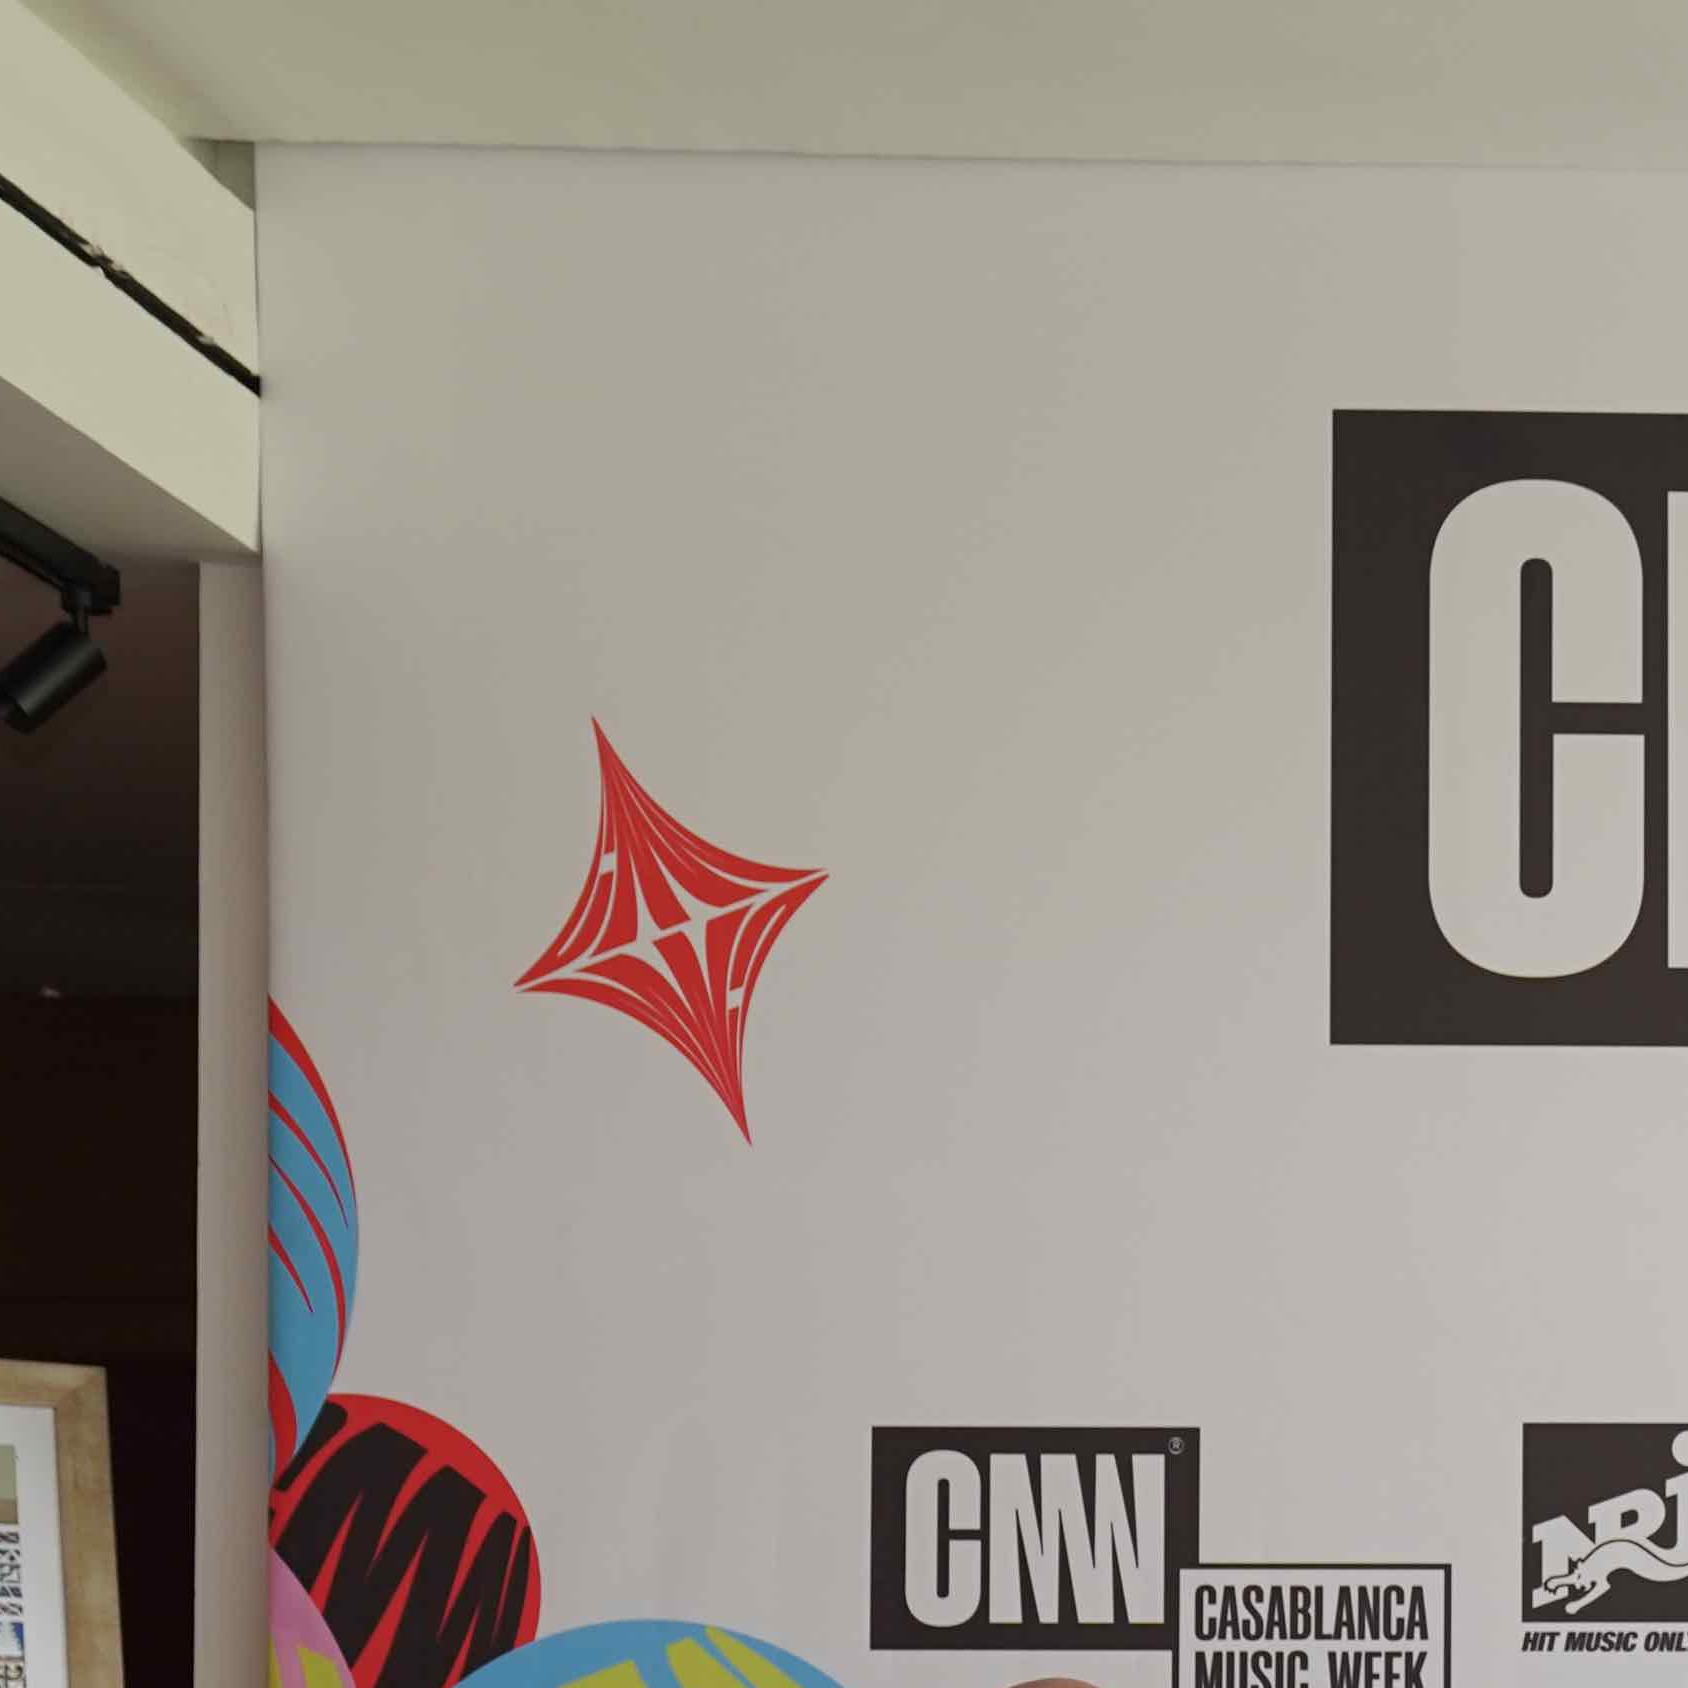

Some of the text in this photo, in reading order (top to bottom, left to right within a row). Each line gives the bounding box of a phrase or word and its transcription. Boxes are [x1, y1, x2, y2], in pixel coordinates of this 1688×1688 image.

[1195, 1585, 1428, 1641] CASABLANCA
[1522, 1632, 1560, 1652] HIT
[1564, 1632, 1639, 1652] MUSIC
